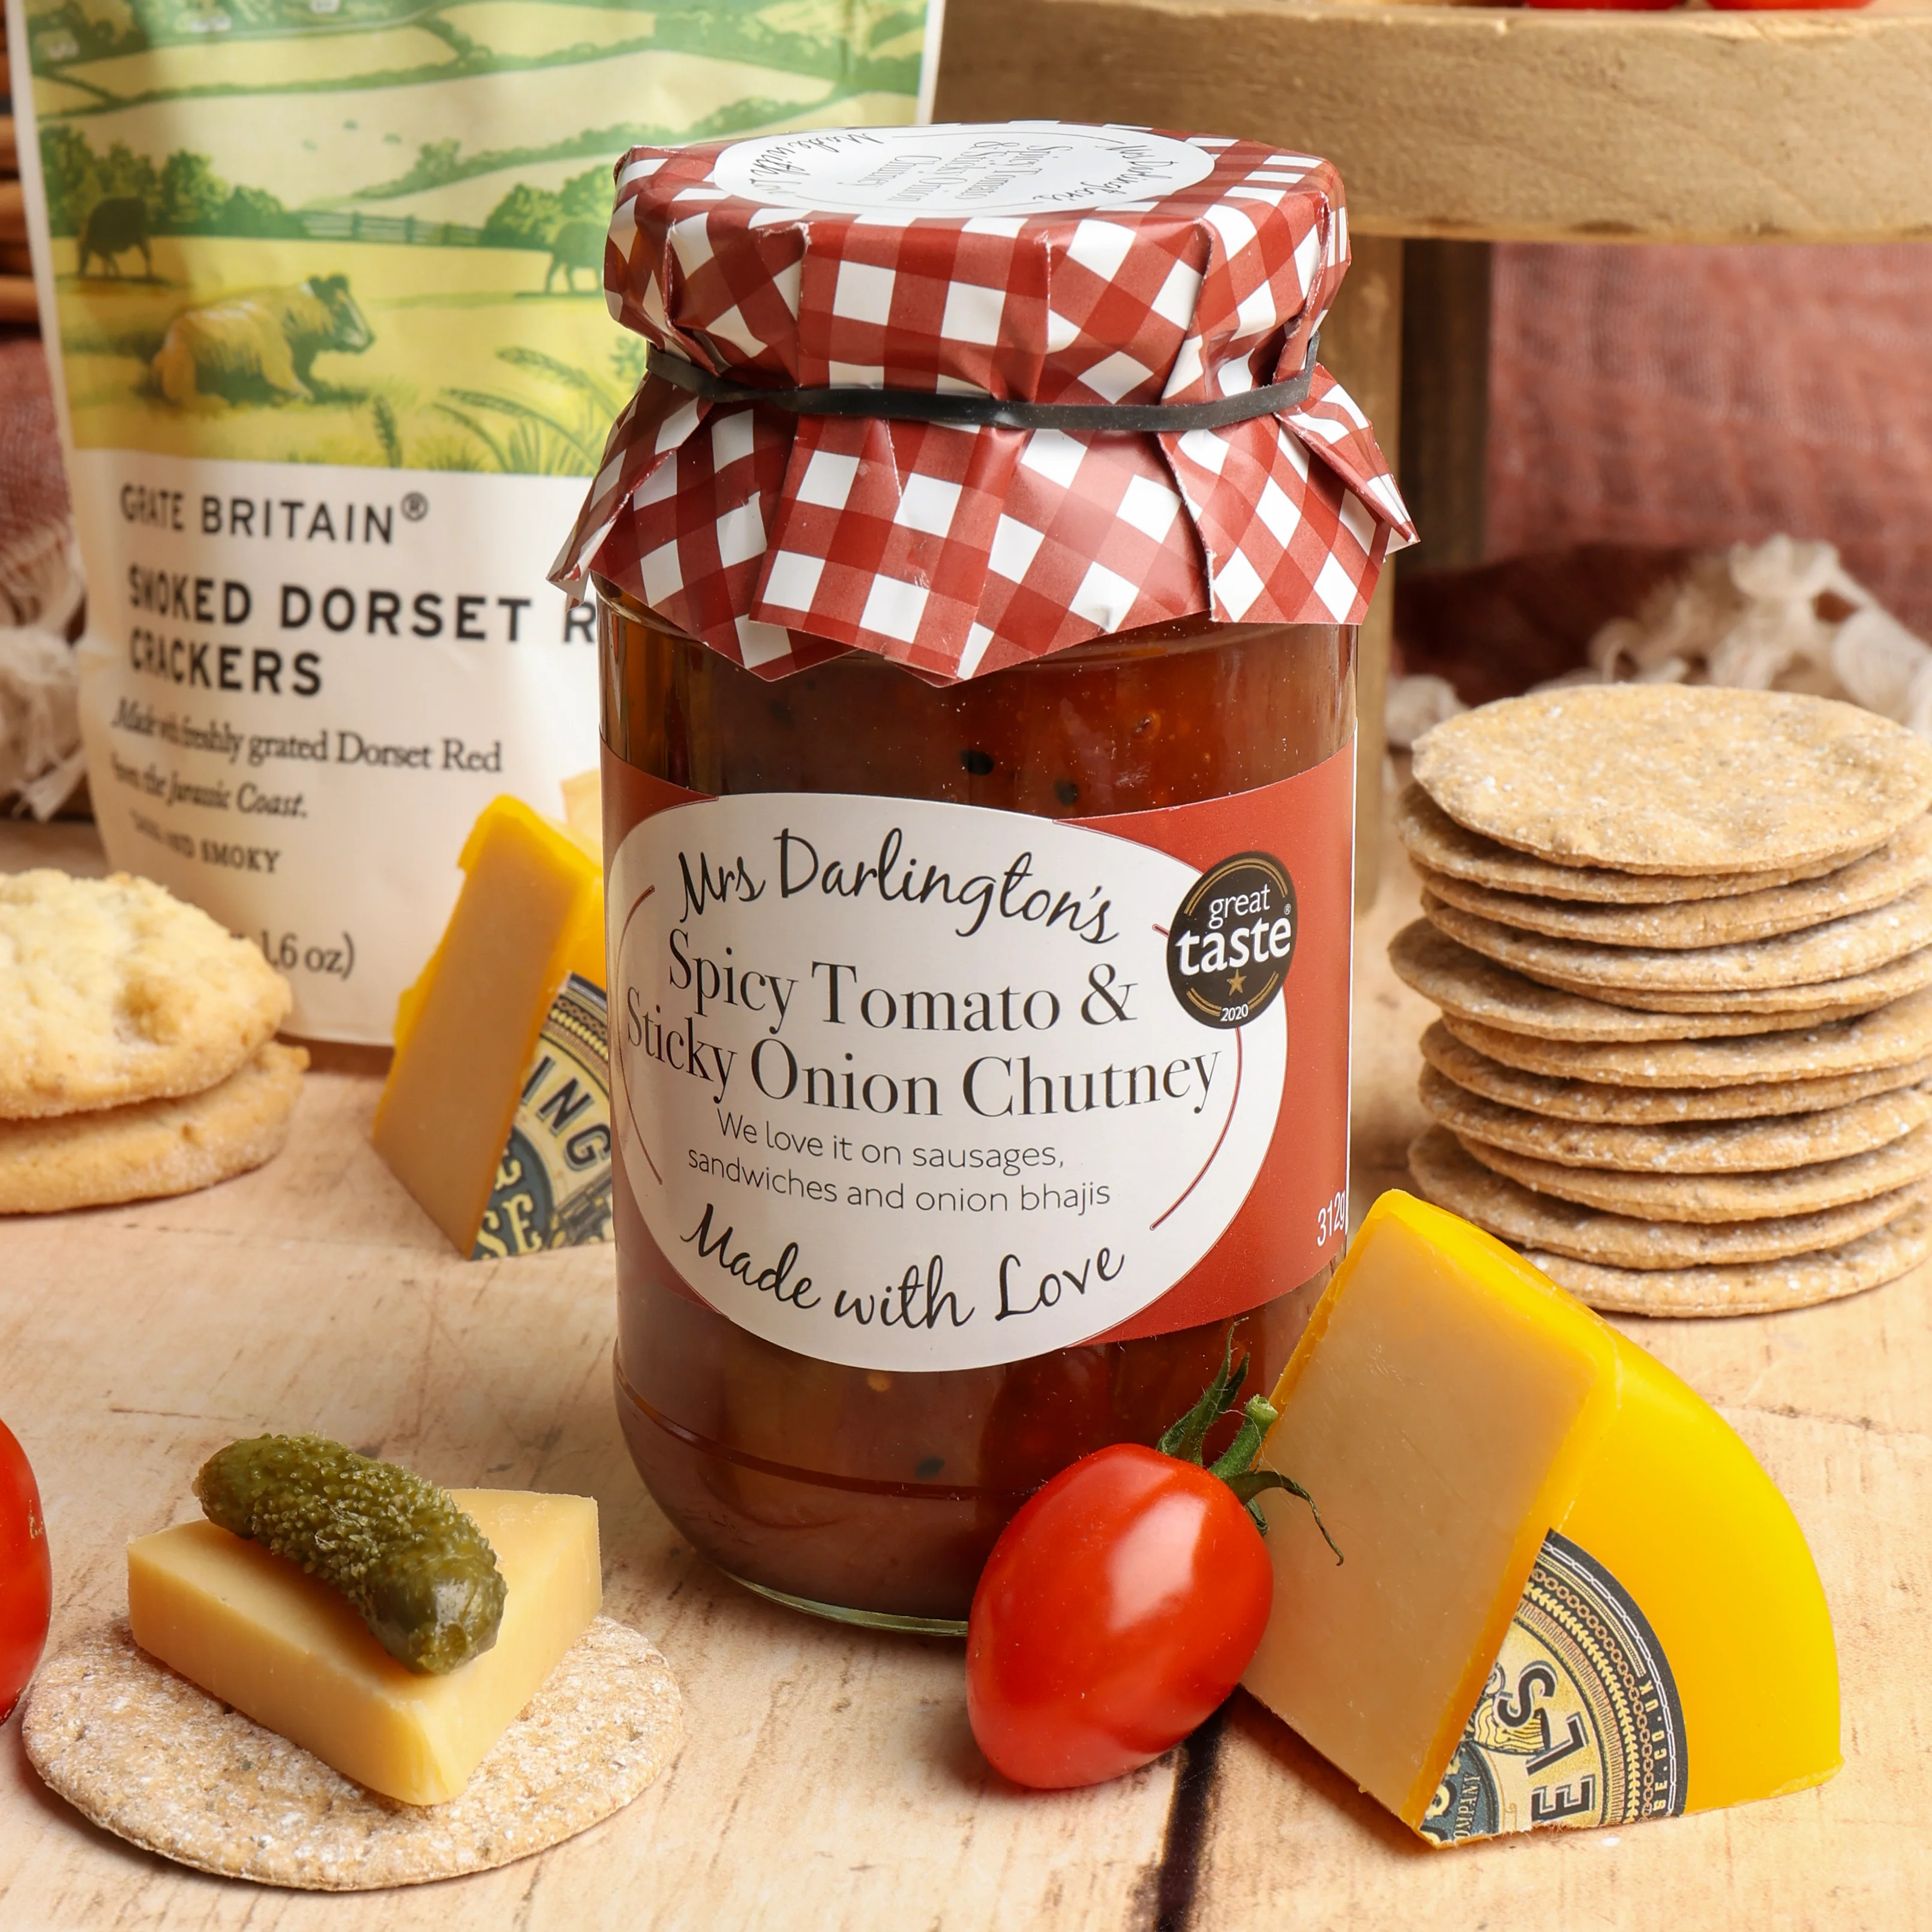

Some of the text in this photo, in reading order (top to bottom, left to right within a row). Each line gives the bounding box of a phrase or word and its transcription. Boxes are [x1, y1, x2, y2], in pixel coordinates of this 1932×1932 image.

[120, 484, 184, 533] GRATE
[129, 565, 251, 626] SMOKED
[281, 584, 531, 643] DORSET
[131, 628, 322, 697] CRACKERS
[249, 730, 328, 766] grated
[337, 731, 431, 769] Dorset
[441, 738, 502, 773] Red
[236, 781, 307, 818] Coast.
[200, 838, 281, 874] SMOKY
[678, 827, 1120, 944] Mrs Darlington's
[1208, 884, 1270, 929] great
[304, 931, 355, 981] oz)
[668, 928, 1138, 1034] Spicy Tomato &
[1220, 1003, 1249, 1022] 2020
[627, 986, 1222, 1117] Sticky Onion Chutney
[717, 1108, 1064, 1177] We love it on sausages,
[688, 1147, 1110, 1217] sandwiches and onion bhajis
[680, 1203, 1125, 1329] Made with Love
[1453, 1772, 1481, 1838] OMPANY
